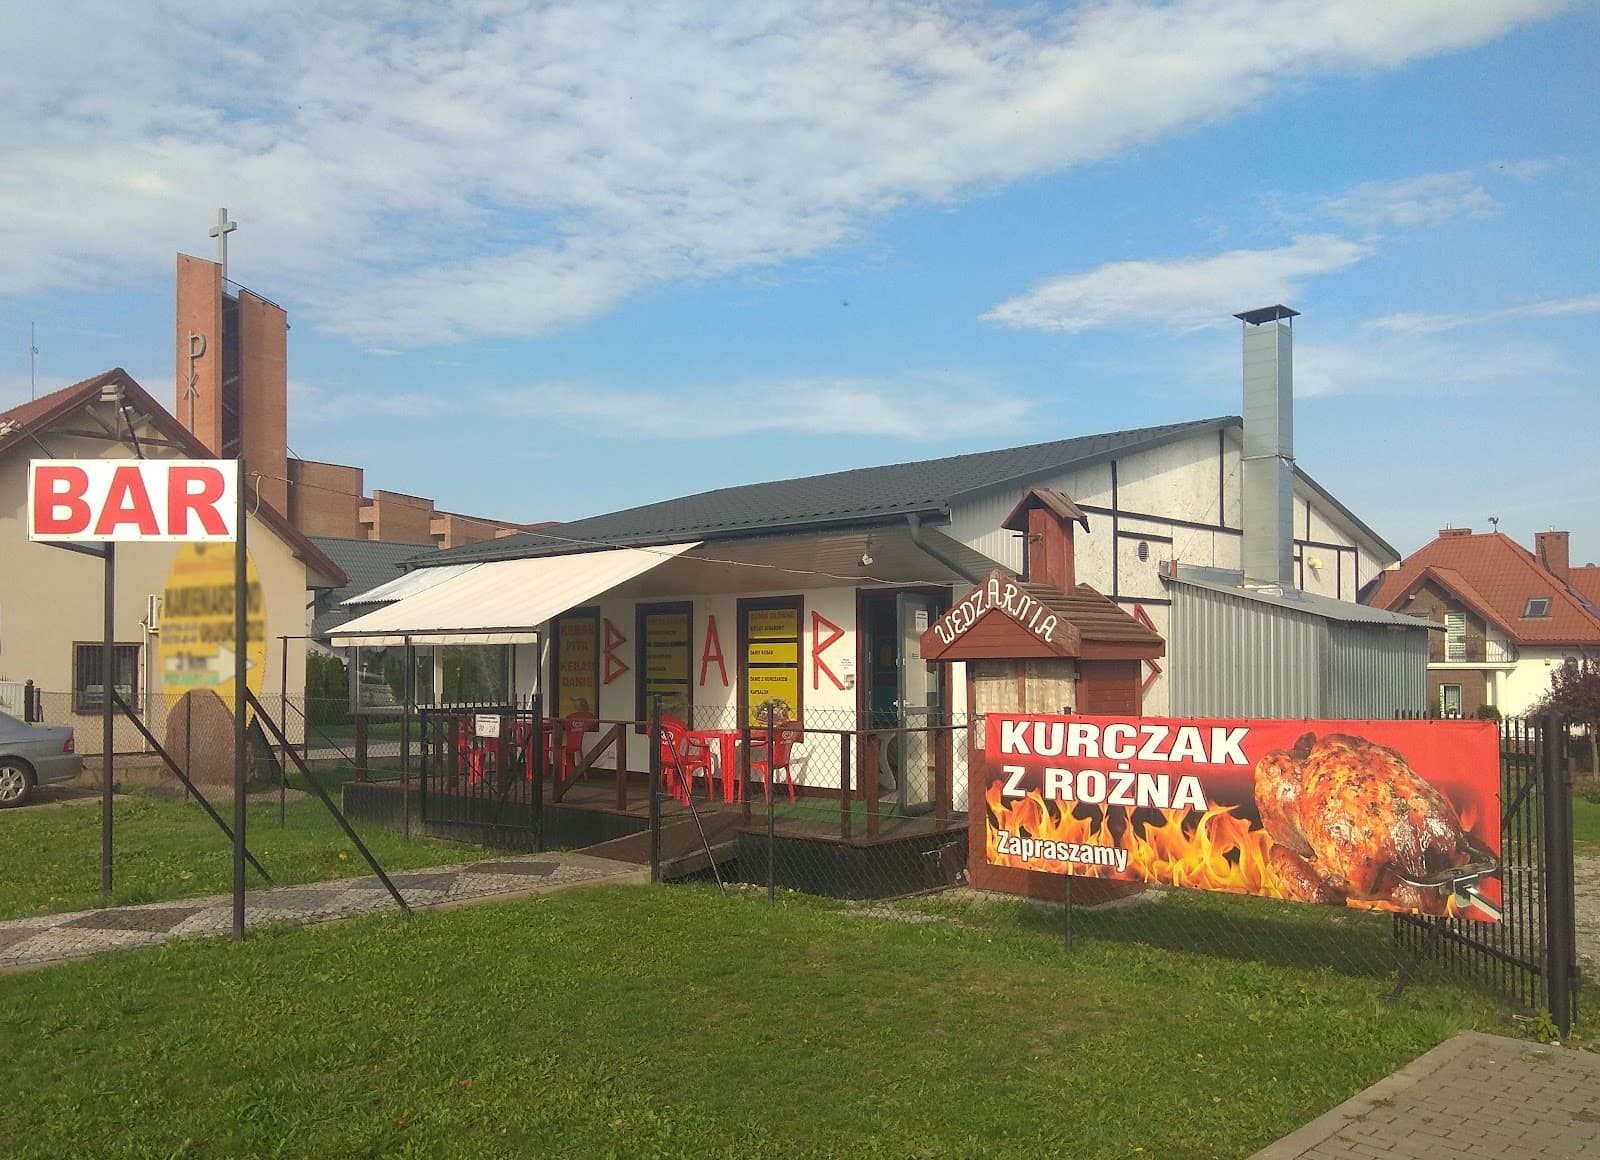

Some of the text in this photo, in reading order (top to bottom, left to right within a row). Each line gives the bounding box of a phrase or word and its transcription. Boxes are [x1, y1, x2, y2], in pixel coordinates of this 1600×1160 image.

[33, 466, 229, 535] BAR
[1000, 720, 1250, 765] KURCZAK
[1002, 762, 1209, 811] Z ROŻNA
[996, 830, 1129, 873] Zapraszamy
